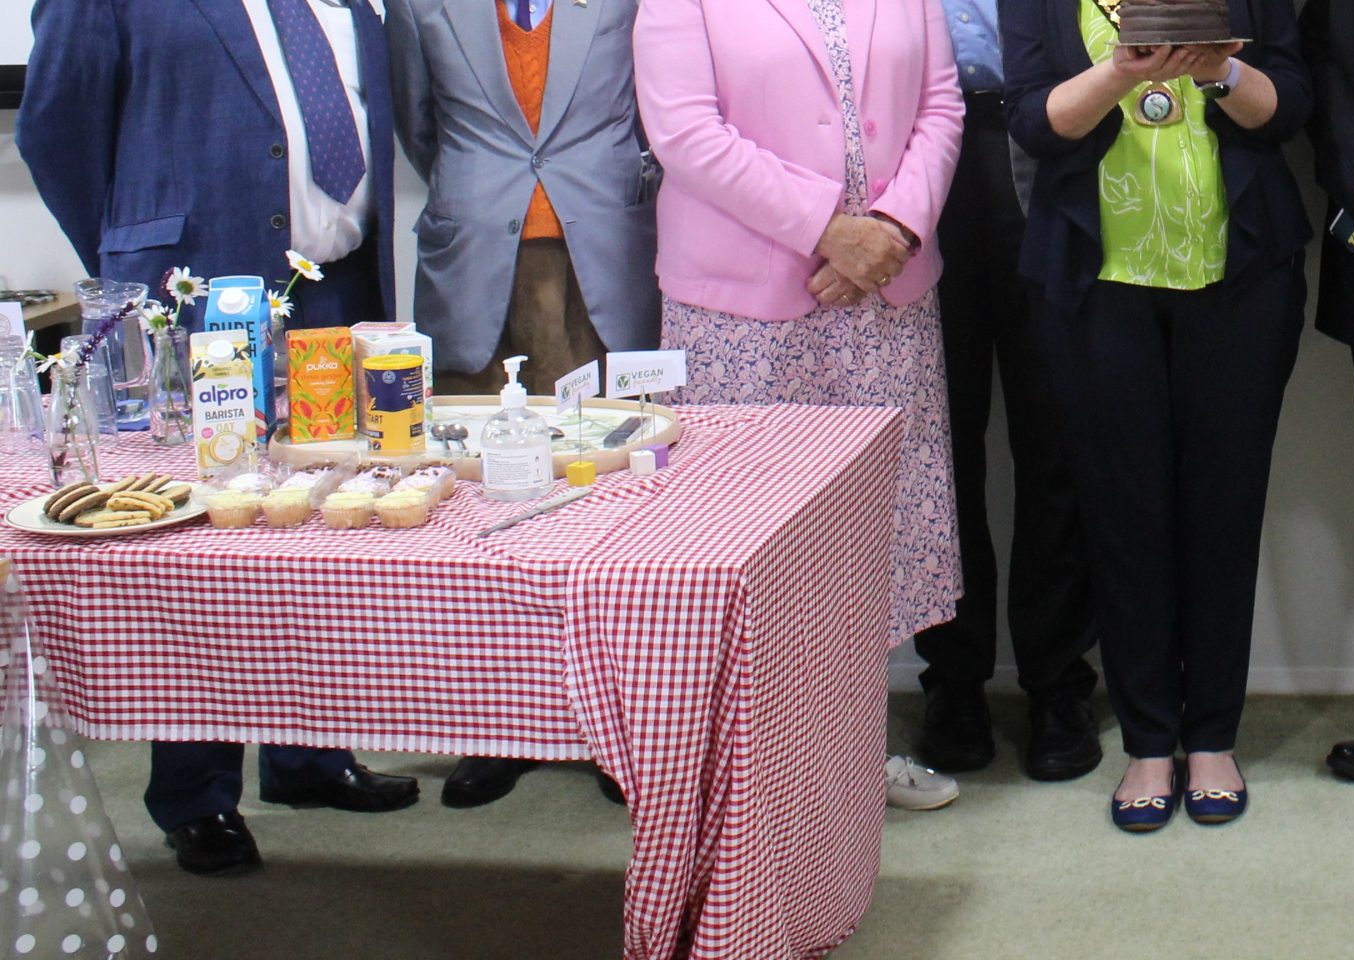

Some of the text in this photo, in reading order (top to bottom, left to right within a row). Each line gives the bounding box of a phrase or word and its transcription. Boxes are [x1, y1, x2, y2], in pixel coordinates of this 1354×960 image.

[306, 360, 338, 372] pukka
[571, 371, 591, 388] VEGAN
[631, 368, 664, 379] VEGAN
[199, 385, 248, 406] alpro
[205, 408, 245, 421] BARISTA
[216, 422, 235, 432] OAT
